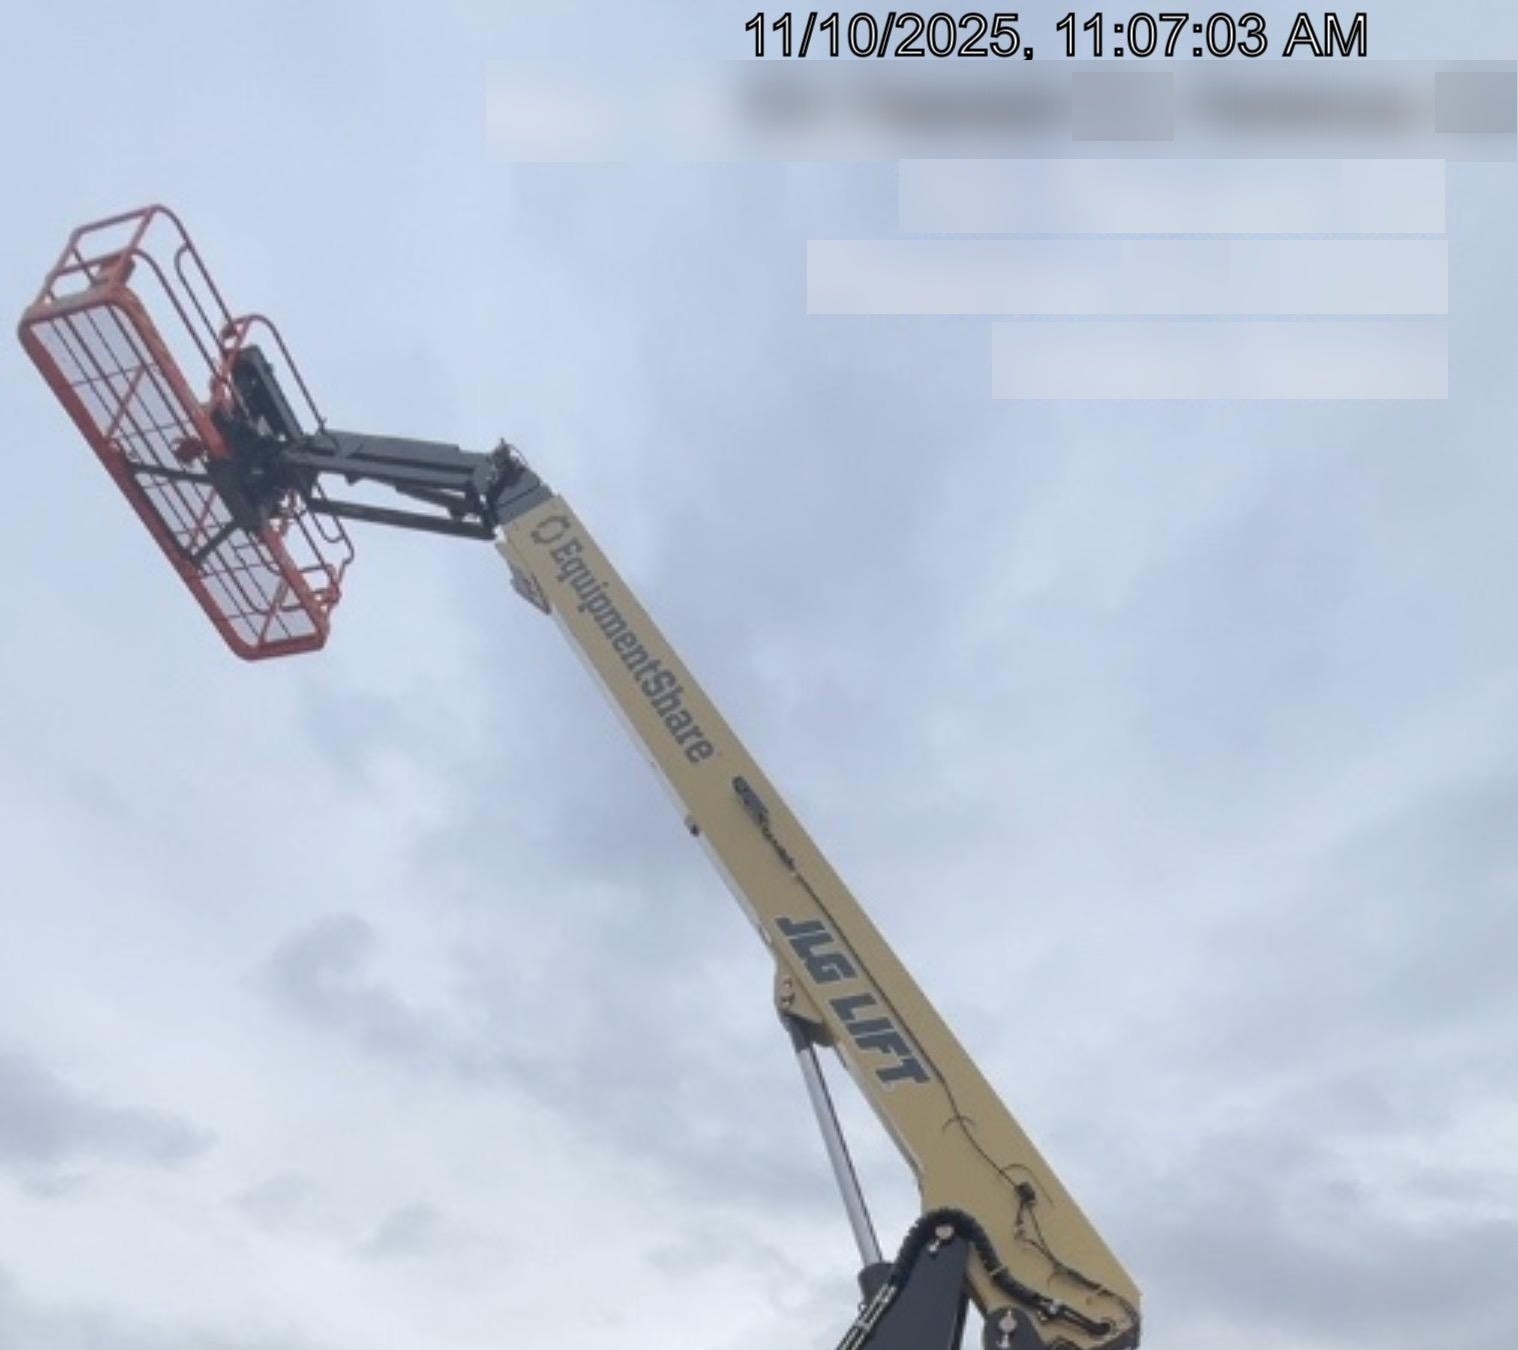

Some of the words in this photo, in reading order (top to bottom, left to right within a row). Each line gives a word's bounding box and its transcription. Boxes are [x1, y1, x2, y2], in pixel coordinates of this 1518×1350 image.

[549, 541, 714, 764] EquipmentShare
[776, 914, 860, 985] JLG
[830, 992, 931, 1086] LIFT
